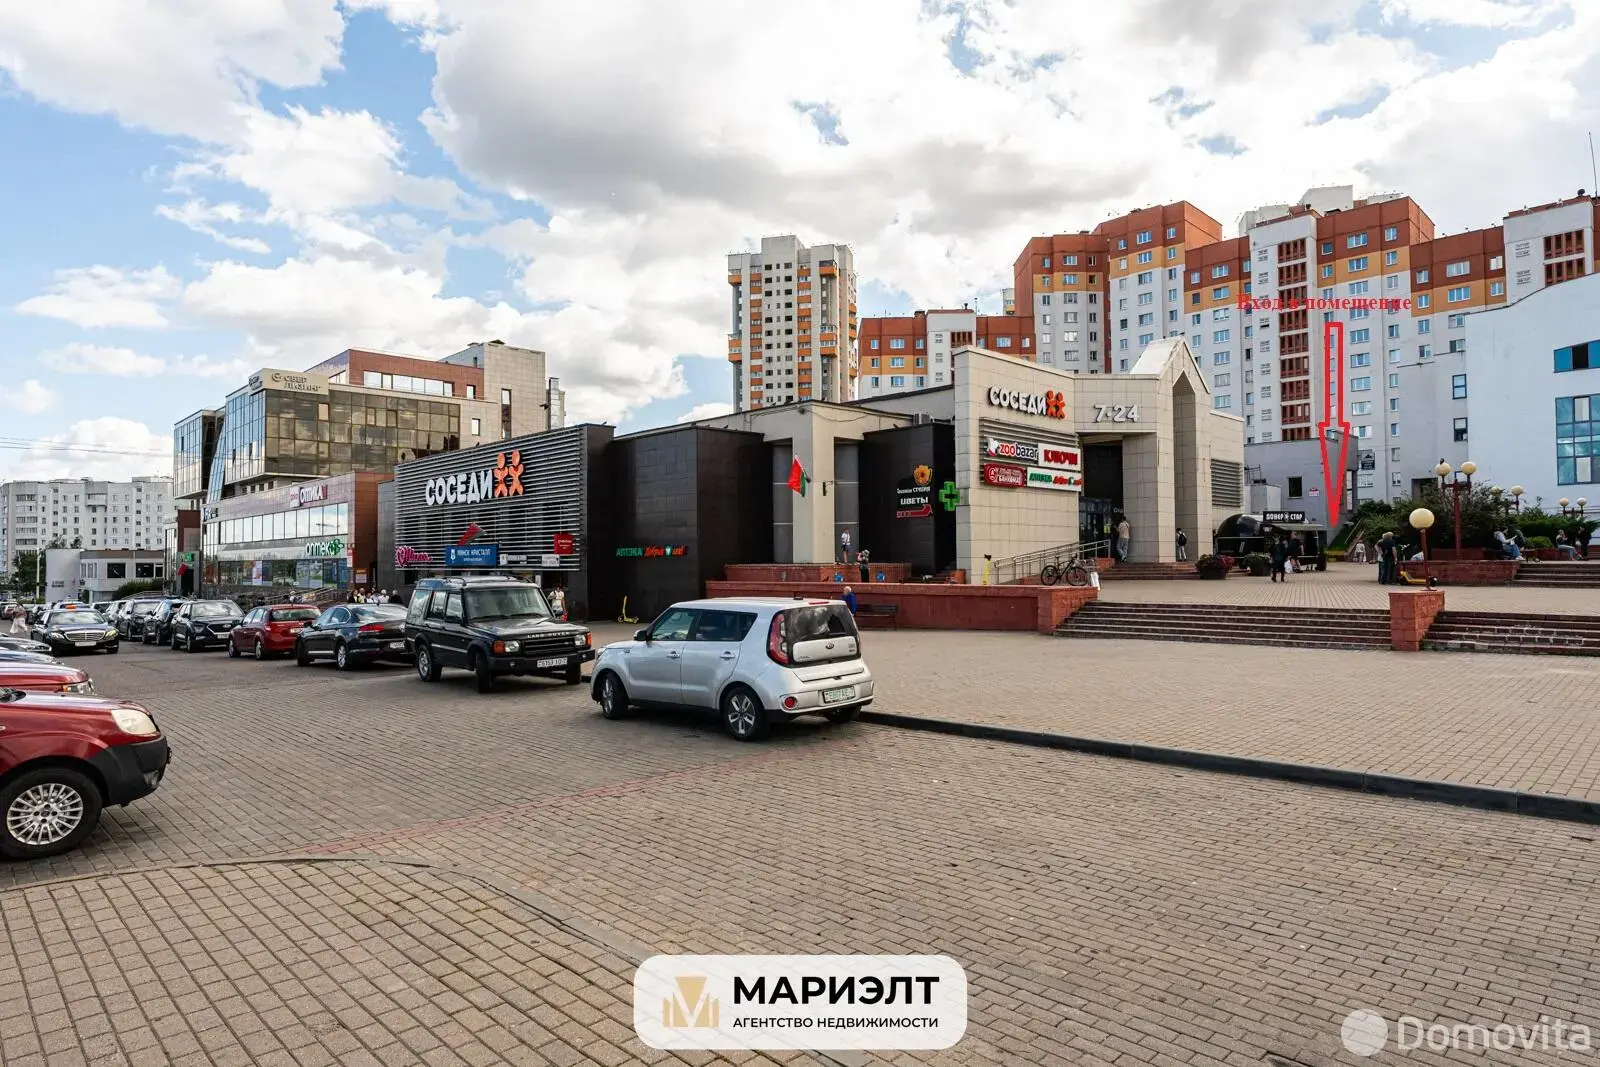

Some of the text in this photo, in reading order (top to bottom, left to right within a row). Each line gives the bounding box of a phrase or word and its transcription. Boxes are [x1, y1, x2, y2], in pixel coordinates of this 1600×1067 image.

[989, 386, 1046, 416] СОСЕДИ
[999, 443, 1038, 460] zoobazar
[1043, 449, 1078, 465] КЛЮЧИ
[299, 485, 324, 503] ОПТИКА
[425, 469, 493, 506] СОСЕДИ
[900, 497, 929, 505] ЦВЕТЫ
[1266, 513, 1283, 521] ДОНЕР
